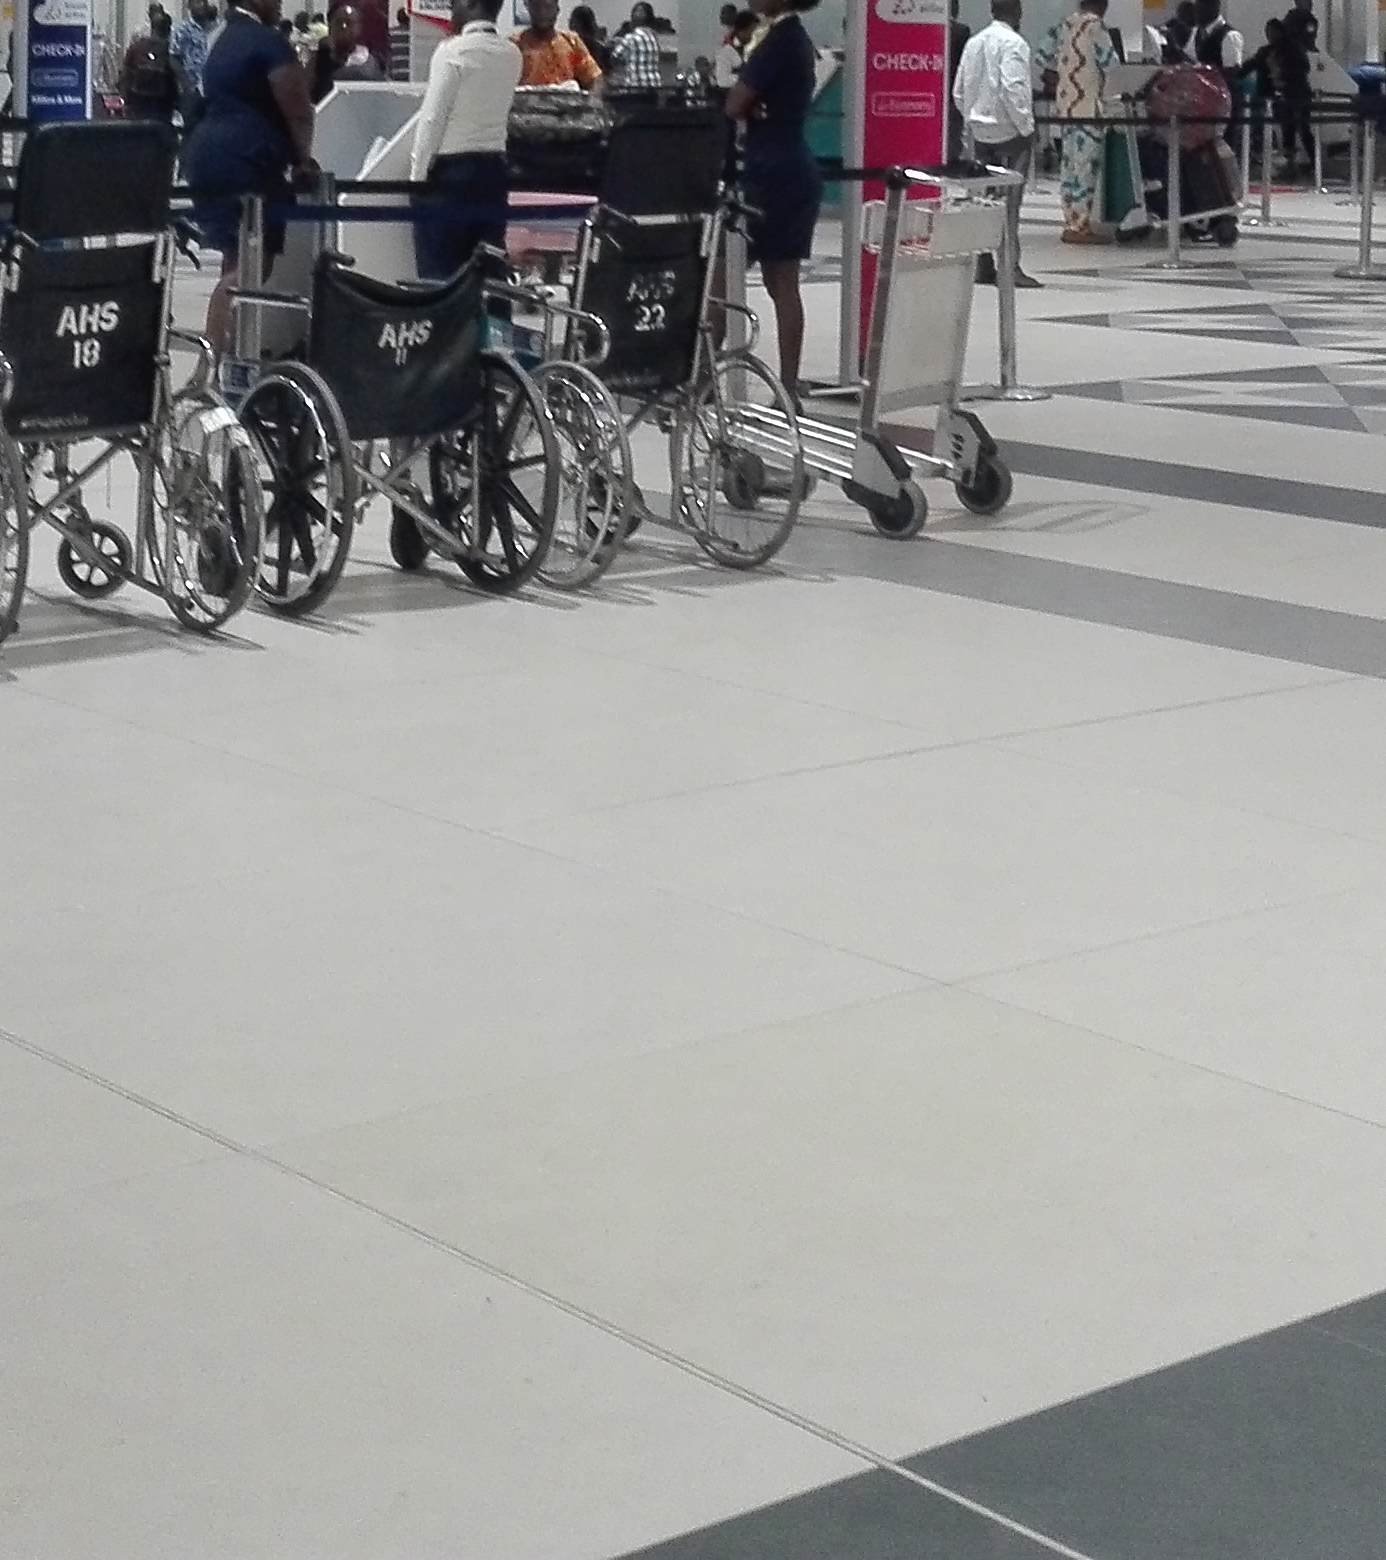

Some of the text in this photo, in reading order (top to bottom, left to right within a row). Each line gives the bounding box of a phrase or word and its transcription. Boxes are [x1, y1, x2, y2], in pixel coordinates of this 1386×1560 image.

[32, 43, 86, 57] CHECK-IN
[873, 52, 944, 72] CHECK-IN
[55, 300, 121, 338] AHS
[634, 303, 666, 331] 22
[377, 319, 433, 349] AHS
[73, 337, 102, 369] 18
